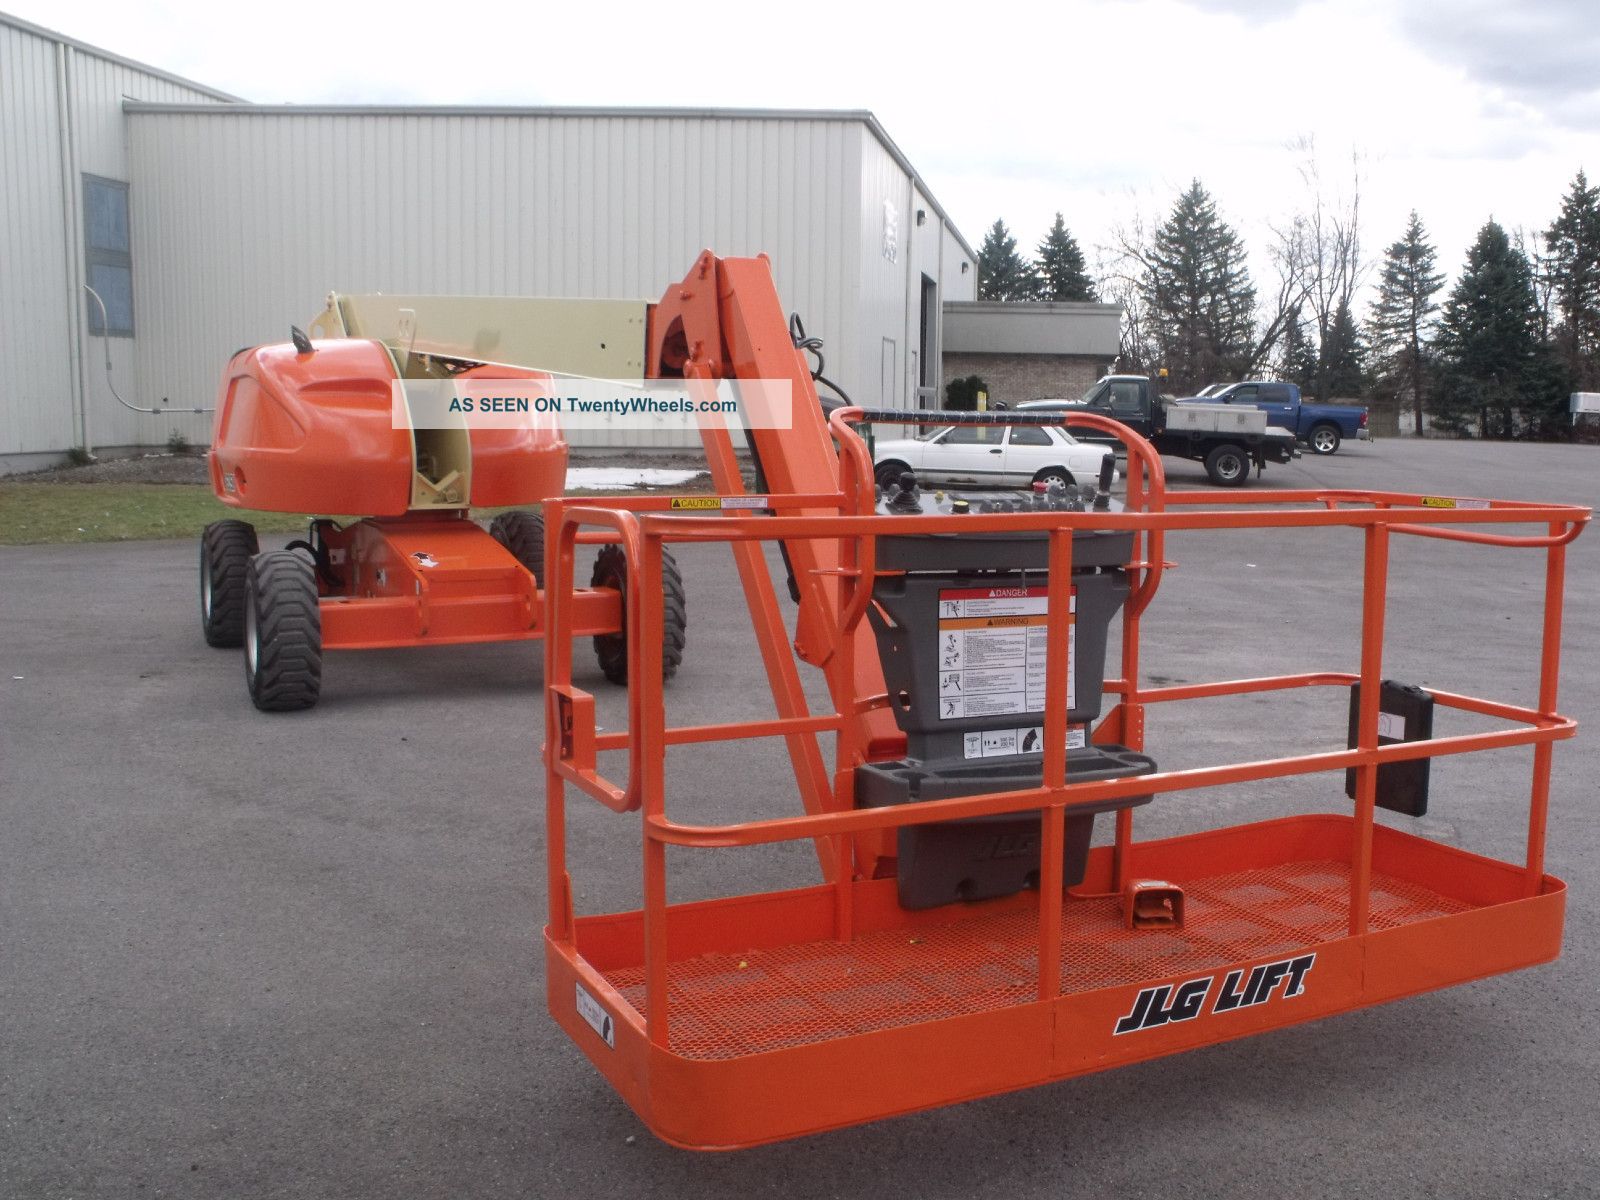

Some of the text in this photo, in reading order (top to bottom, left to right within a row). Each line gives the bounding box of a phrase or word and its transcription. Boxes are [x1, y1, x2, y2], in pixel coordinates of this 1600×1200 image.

[681, 498, 719, 508] CAUTION
[1428, 498, 1455, 507] CAUTION
[996, 588, 1028, 597] DANGER
[993, 617, 1029, 625] WARNING
[1112, 952, 1316, 1036] JLG LIFT
